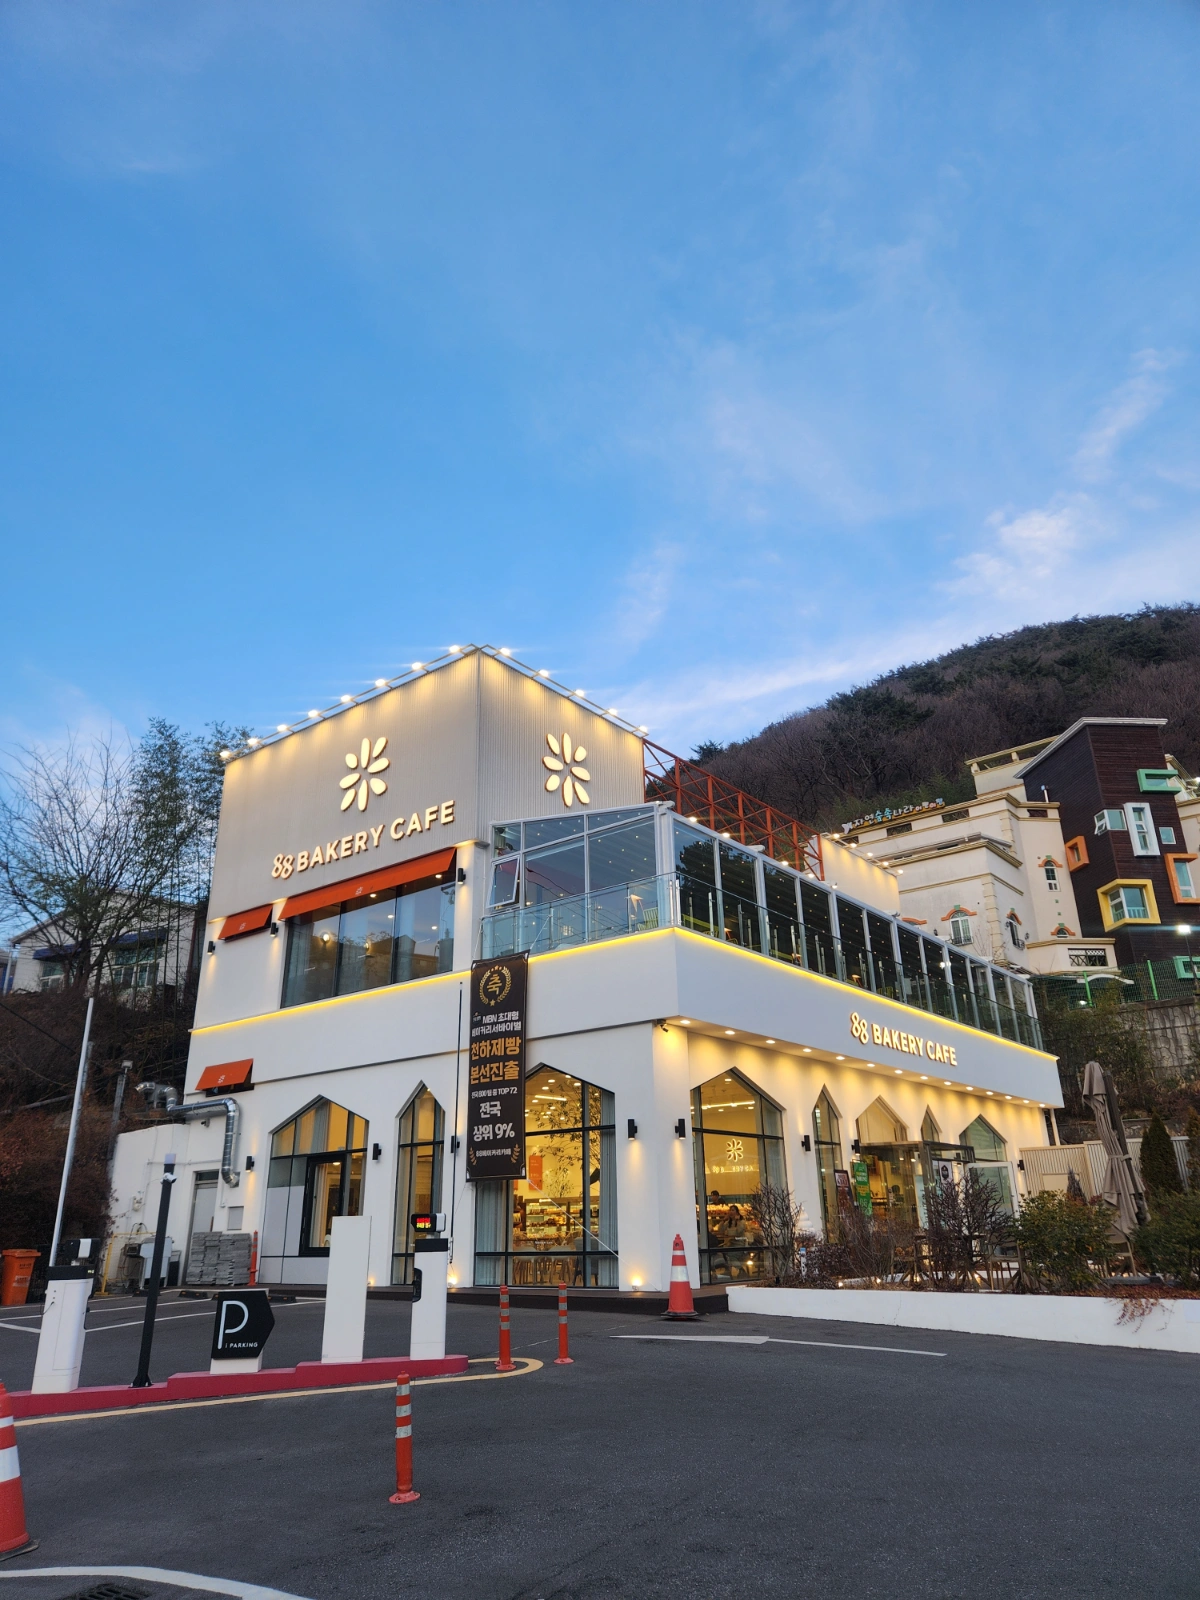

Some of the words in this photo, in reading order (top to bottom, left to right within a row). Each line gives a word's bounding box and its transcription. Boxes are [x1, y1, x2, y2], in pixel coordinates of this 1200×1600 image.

[271, 853, 295, 880] 88
[297, 824, 385, 873] BAKERY
[390, 800, 455, 841] CAFE
[486, 974, 502, 994] 축
[482, 1014, 497, 1024] MBN
[498, 1011, 519, 1022] 초대형
[471, 1036, 521, 1060] 천하제빵
[851, 1012, 869, 1045] 88
[871, 1023, 923, 1057] BAKERY
[926, 1040, 958, 1066] CAFE
[470, 1060, 520, 1084] 본선진출
[480, 1101, 501, 1118] 전국
[473, 1124, 493, 1141] 상위
[494, 1123, 515, 1139] 9%
[218, 1300, 248, 1349] P
